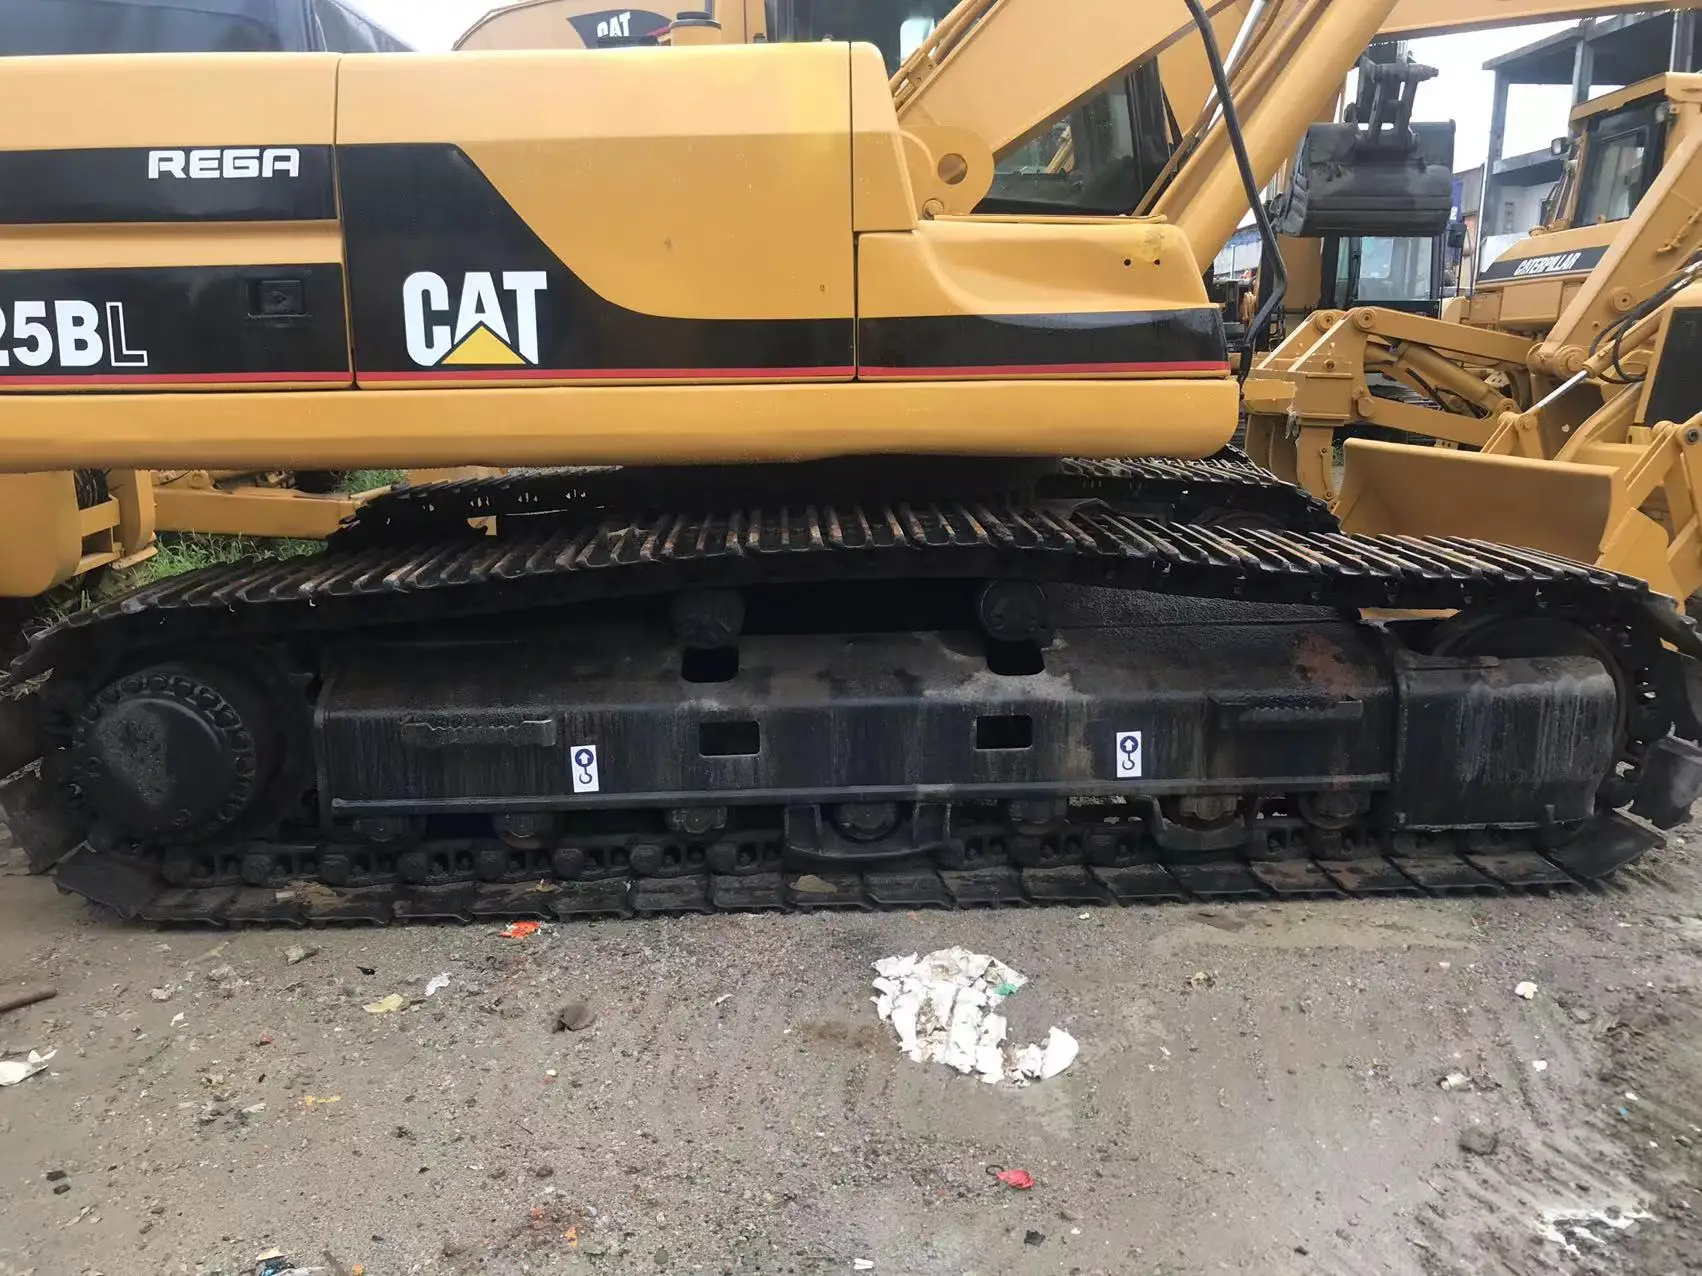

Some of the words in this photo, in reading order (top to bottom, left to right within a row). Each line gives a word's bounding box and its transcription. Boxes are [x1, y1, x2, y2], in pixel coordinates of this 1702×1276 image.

[148, 148, 300, 179] REGA
[1514, 252, 1582, 276] CATERPILLAR
[0, 300, 148, 367] 5BL
[402, 270, 548, 367] CAT
